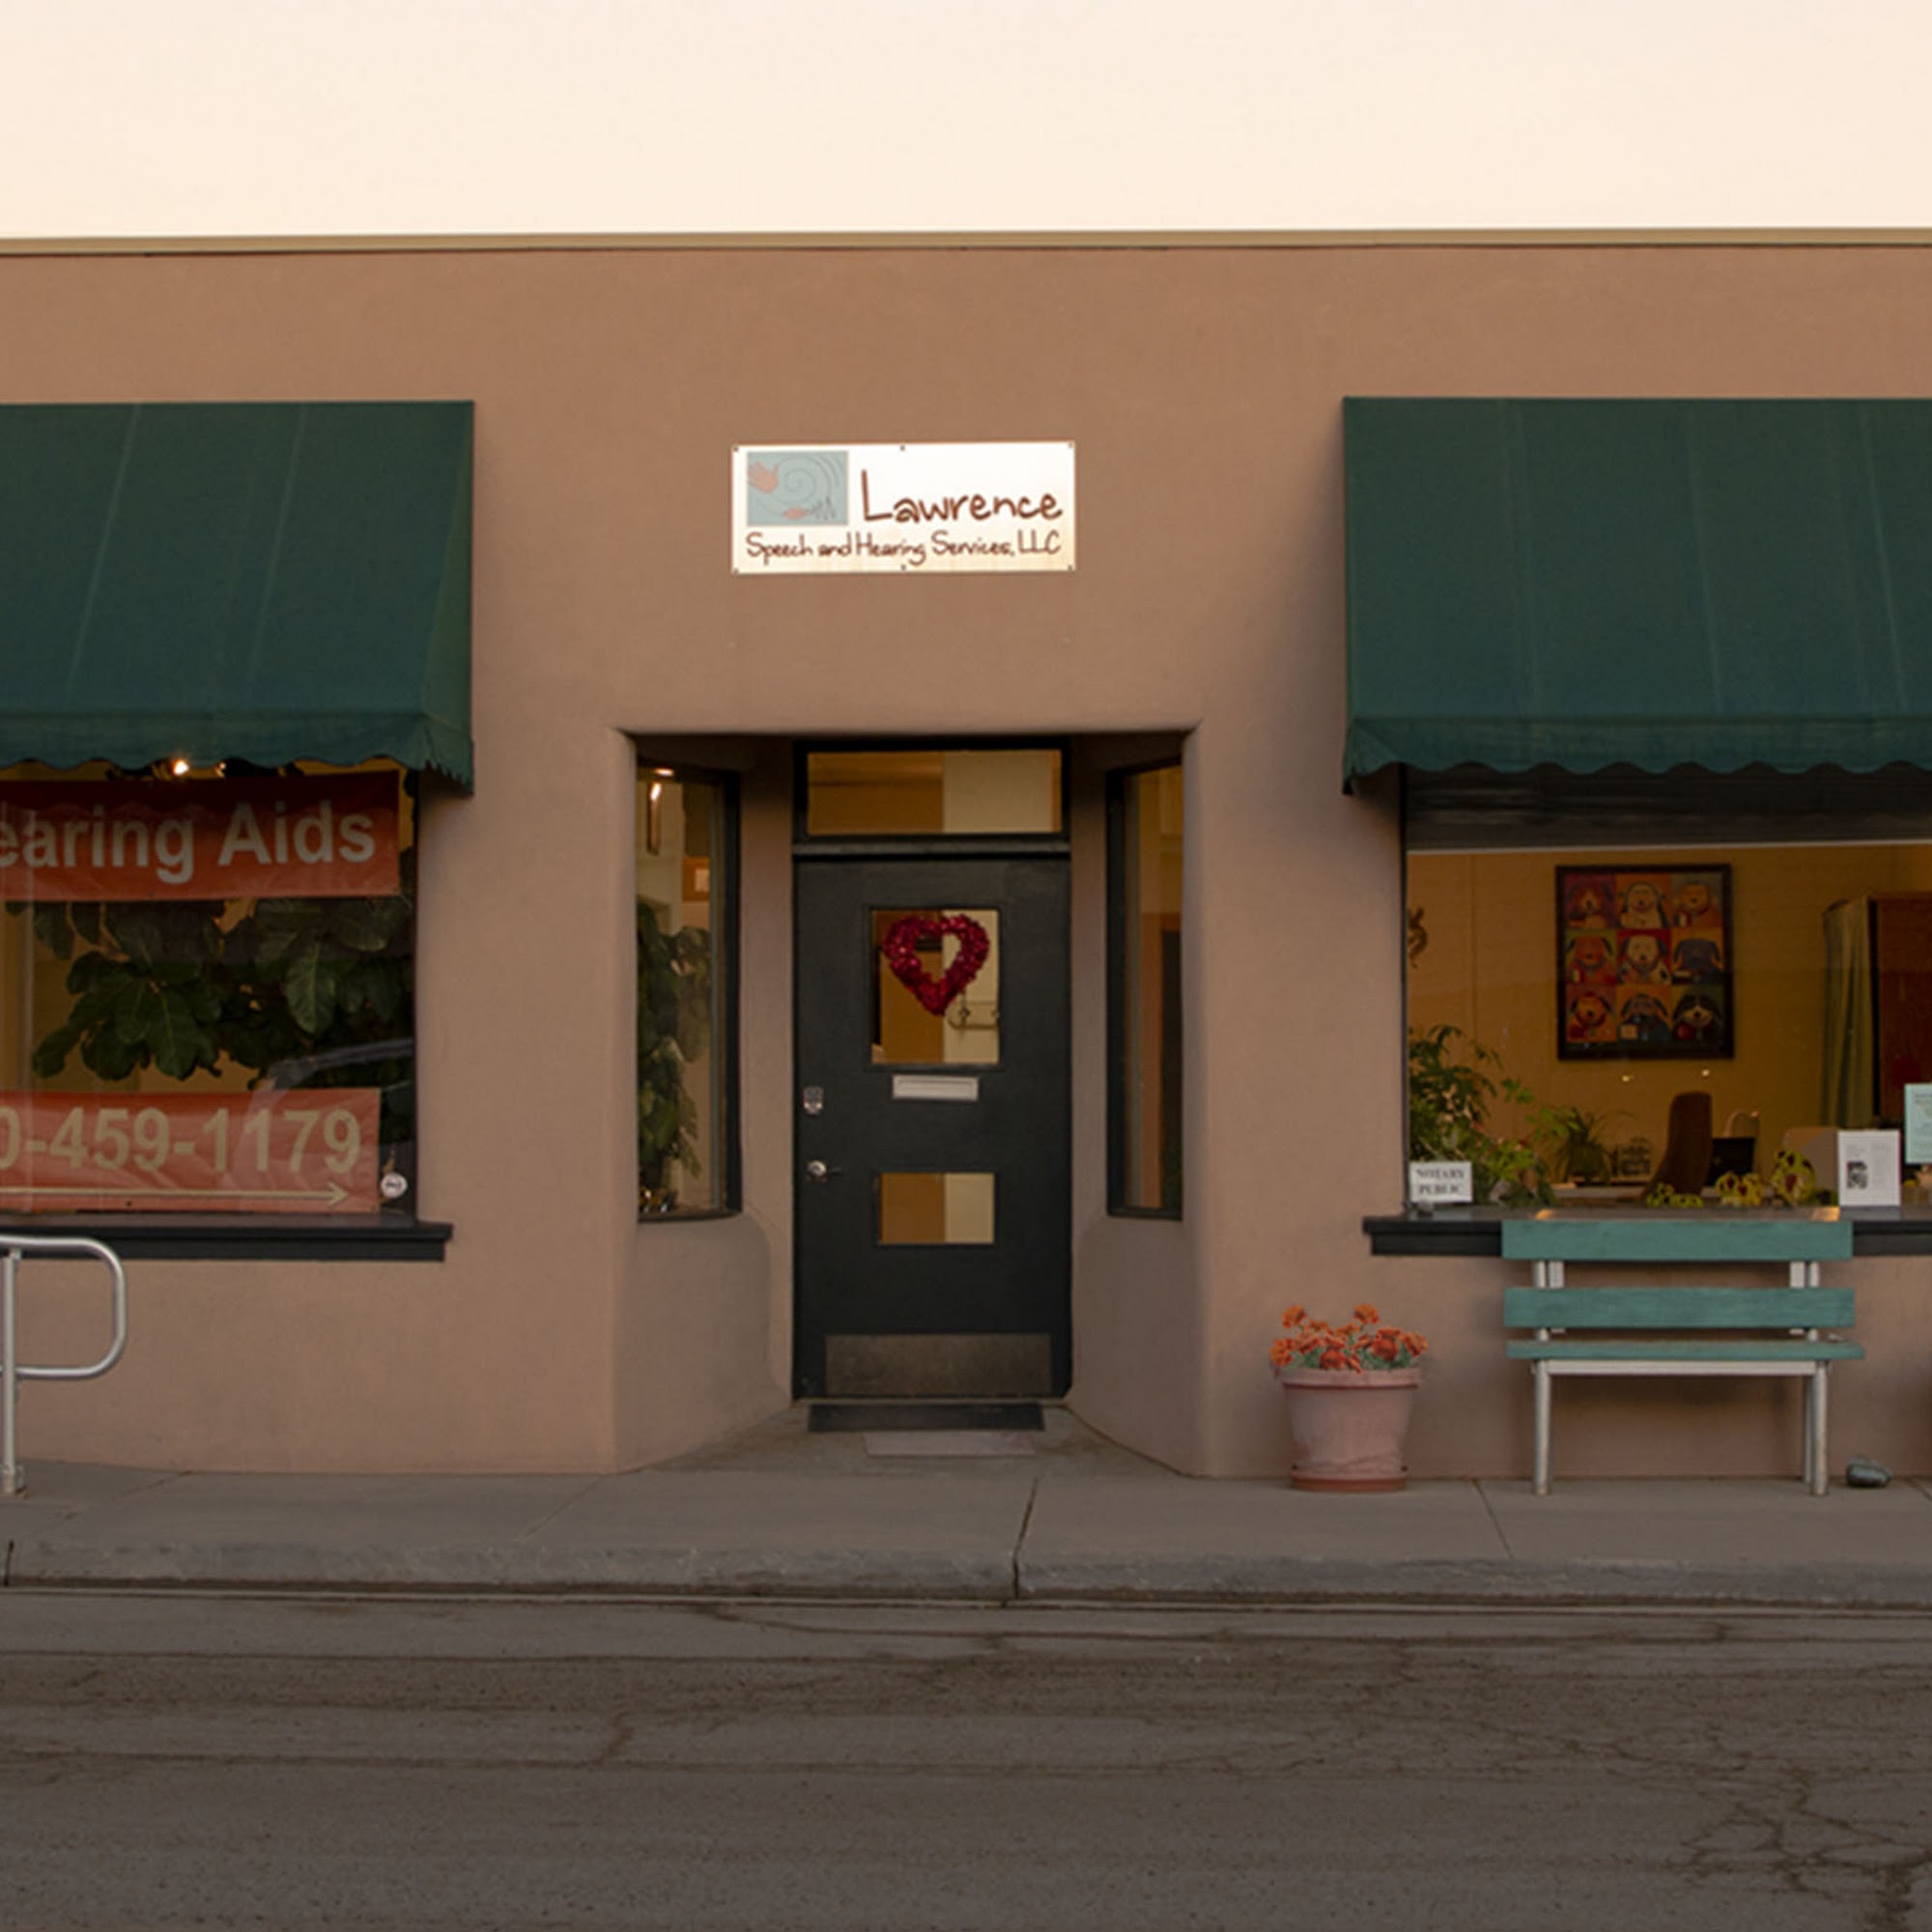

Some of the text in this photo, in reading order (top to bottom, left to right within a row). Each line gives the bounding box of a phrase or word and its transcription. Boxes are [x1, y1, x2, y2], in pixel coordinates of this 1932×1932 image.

[861, 469, 1064, 523] Lawrence
[746, 529, 1061, 566] Speech and Hearing Services, LLC
[217, 801, 377, 866] Aids
